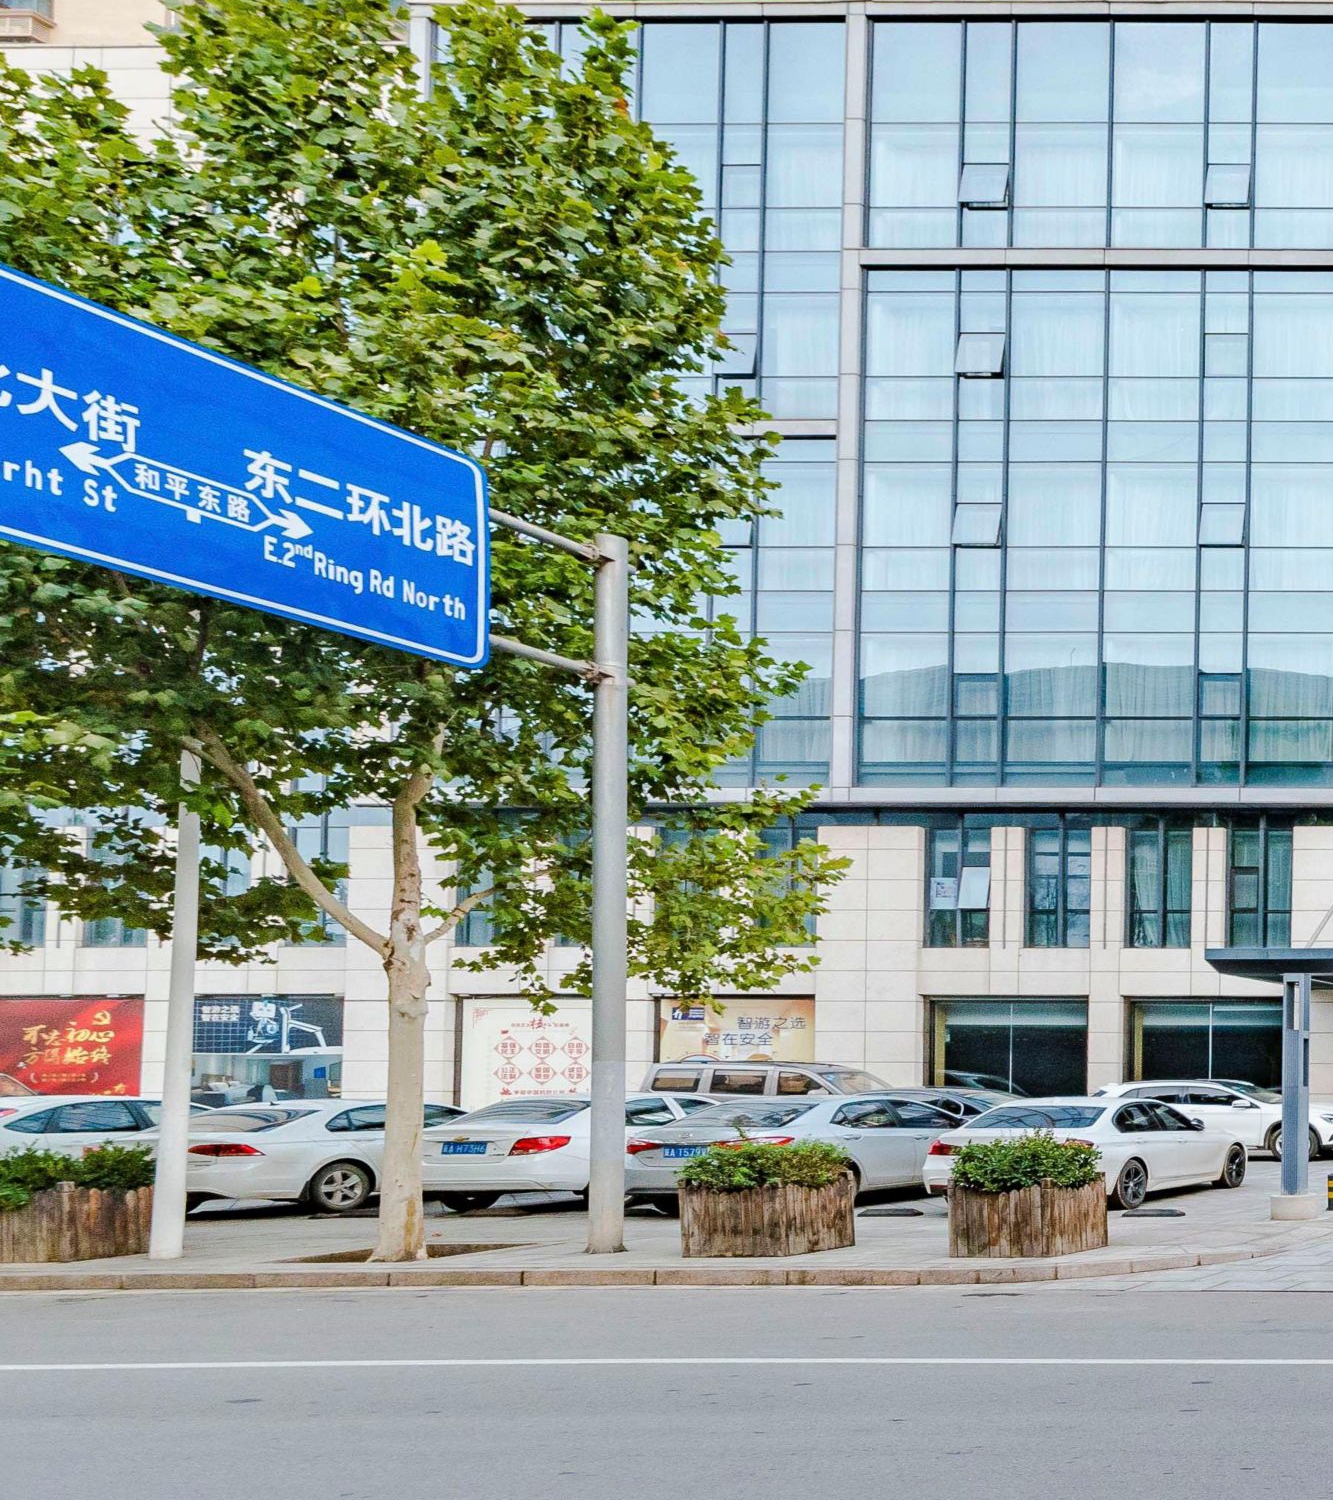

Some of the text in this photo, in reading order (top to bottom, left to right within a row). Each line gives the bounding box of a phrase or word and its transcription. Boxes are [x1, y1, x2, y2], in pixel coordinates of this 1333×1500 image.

[82, 478, 118, 513] St
[133, 462, 251, 523] 和平东路
[243, 448, 477, 567] 东二环北路
[369, 568, 395, 599] Rd
[402, 579, 466, 621] North
[23, 1020, 116, 1046] 不忘初心
[704, 1032, 773, 1046] 智在安全
[737, 1016, 807, 1030] 智游之选
